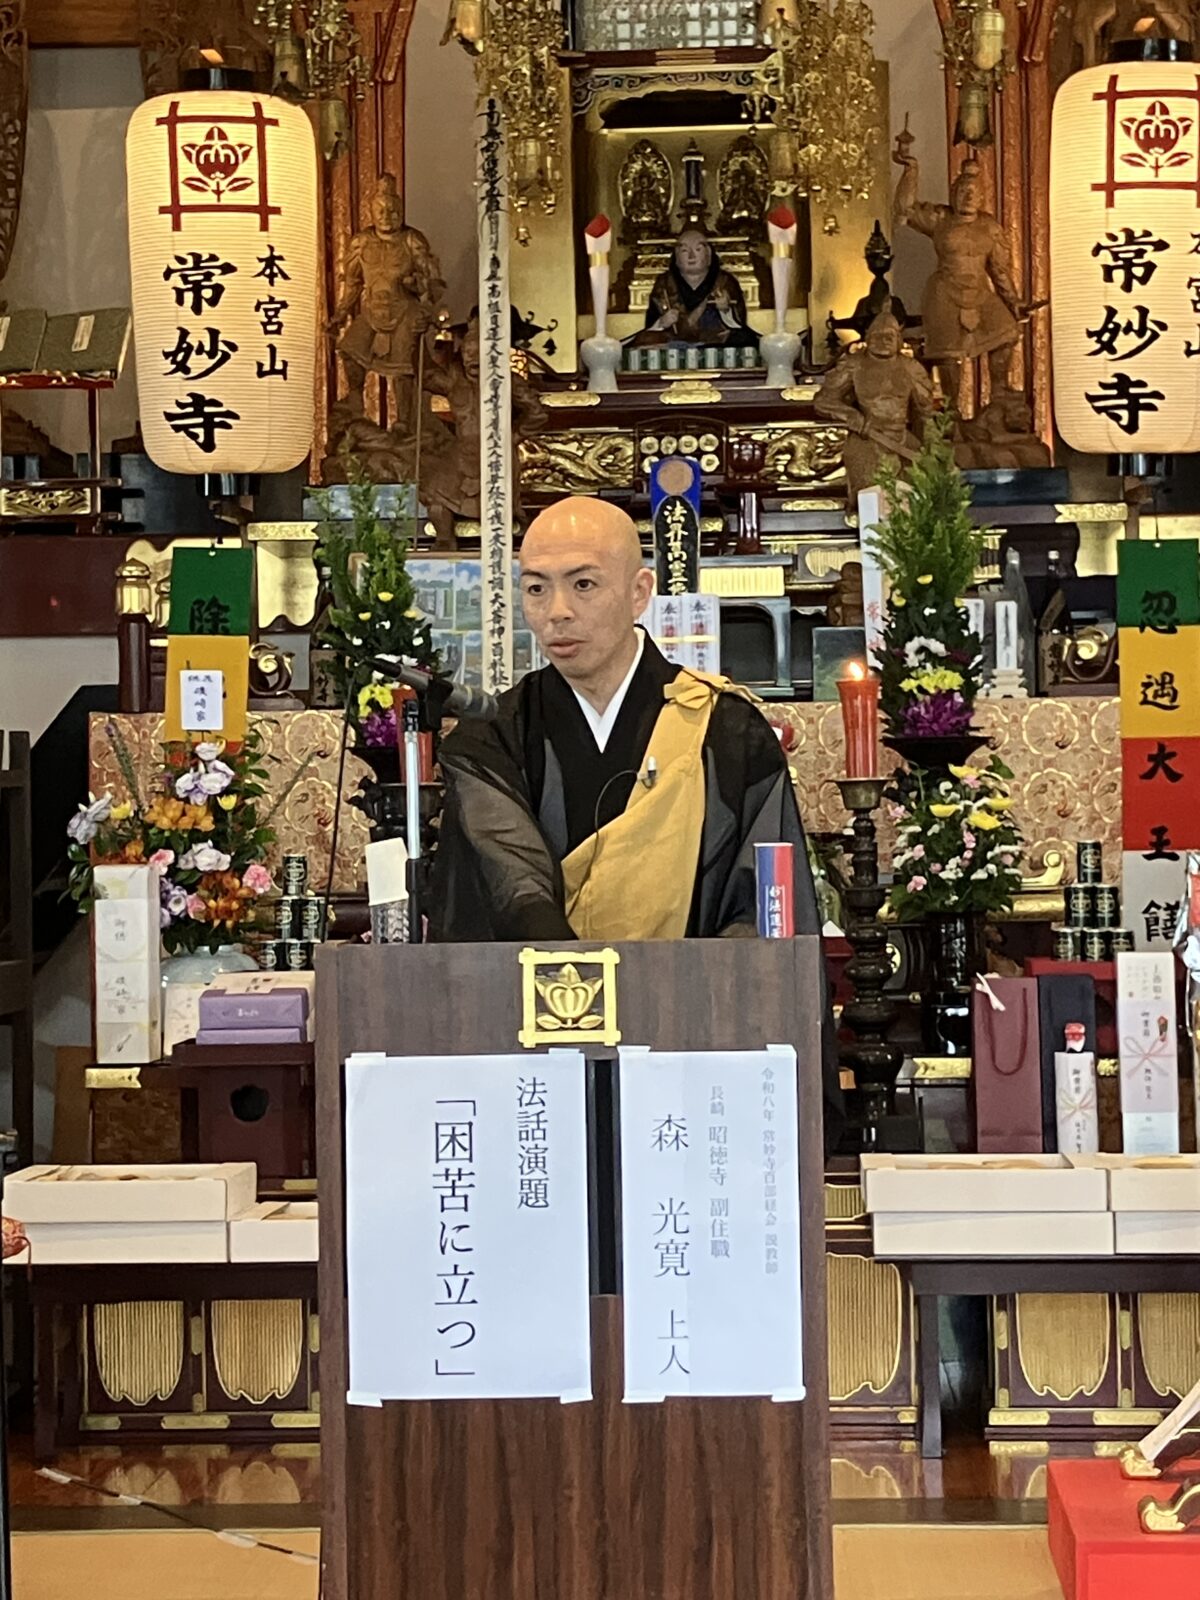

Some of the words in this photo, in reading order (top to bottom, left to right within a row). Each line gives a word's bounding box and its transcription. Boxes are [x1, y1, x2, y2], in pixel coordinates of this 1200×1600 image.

[162, 251, 241, 454] 常妙寺
[252, 244, 292, 382] 本宮山
[1084, 227, 1171, 436] 常妙寺
[516, 1075, 550, 1210] 法話演題
[651, 1113, 689, 1153] 森
[708, 1125, 728, 1187] 昭徳寺
[432, 1099, 479, 1377] 「困苦に立つ」
[651, 1197, 691, 1278] 光寛
[710, 1197, 731, 1260] 副住職
[657, 1309, 691, 1376] 上人
